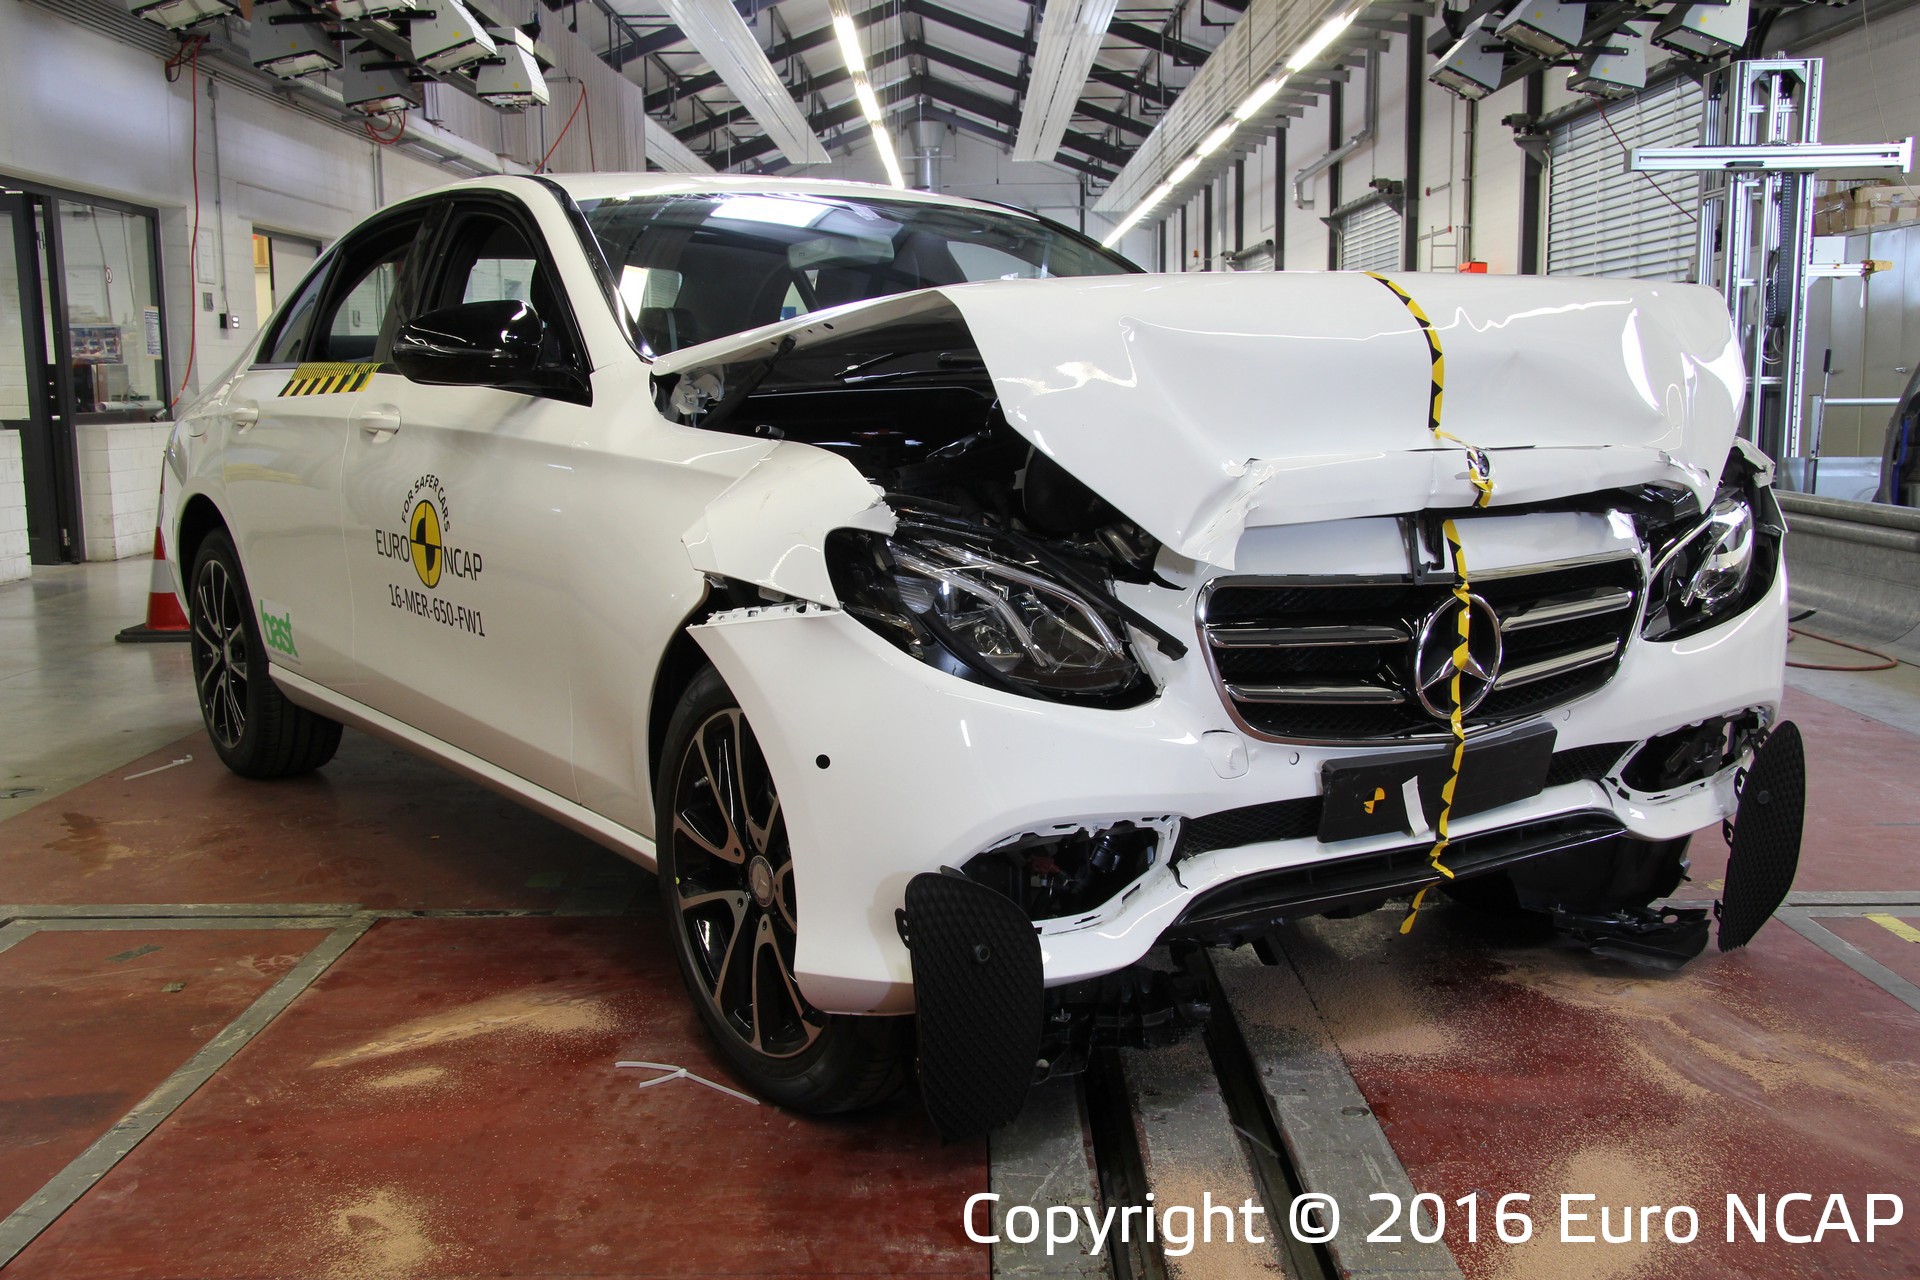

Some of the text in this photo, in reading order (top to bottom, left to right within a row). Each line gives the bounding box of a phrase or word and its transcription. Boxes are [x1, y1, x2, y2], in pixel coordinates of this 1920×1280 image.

[401, 473, 451, 533] FOR SAFER CARS
[375, 529, 483, 581] EURO NCAP
[388, 583, 486, 637] 16-MER-650-FW1
